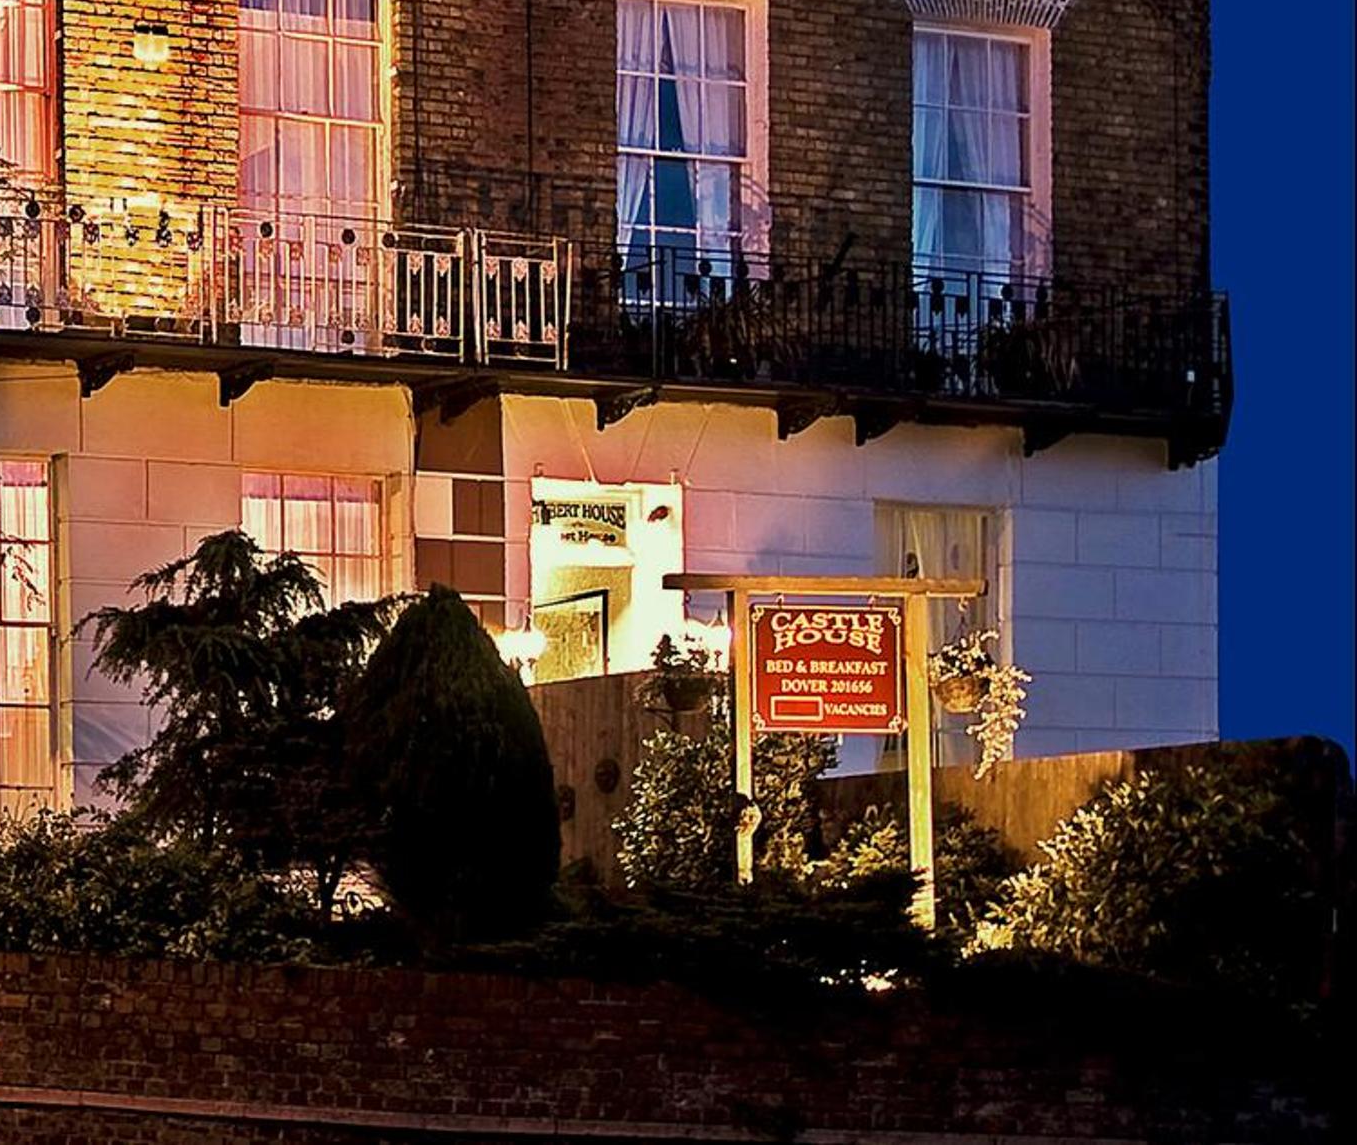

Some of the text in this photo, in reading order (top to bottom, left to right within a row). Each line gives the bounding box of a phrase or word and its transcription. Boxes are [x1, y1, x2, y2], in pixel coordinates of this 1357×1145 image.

[582, 504, 626, 530] HOUSE
[771, 612, 884, 634] CASTLE
[773, 629, 883, 655] HOUSE
[765, 660, 888, 675] BED & BREAKFAST
[781, 679, 873, 694] DOVER 201656
[824, 703, 888, 716] VACANCIES
